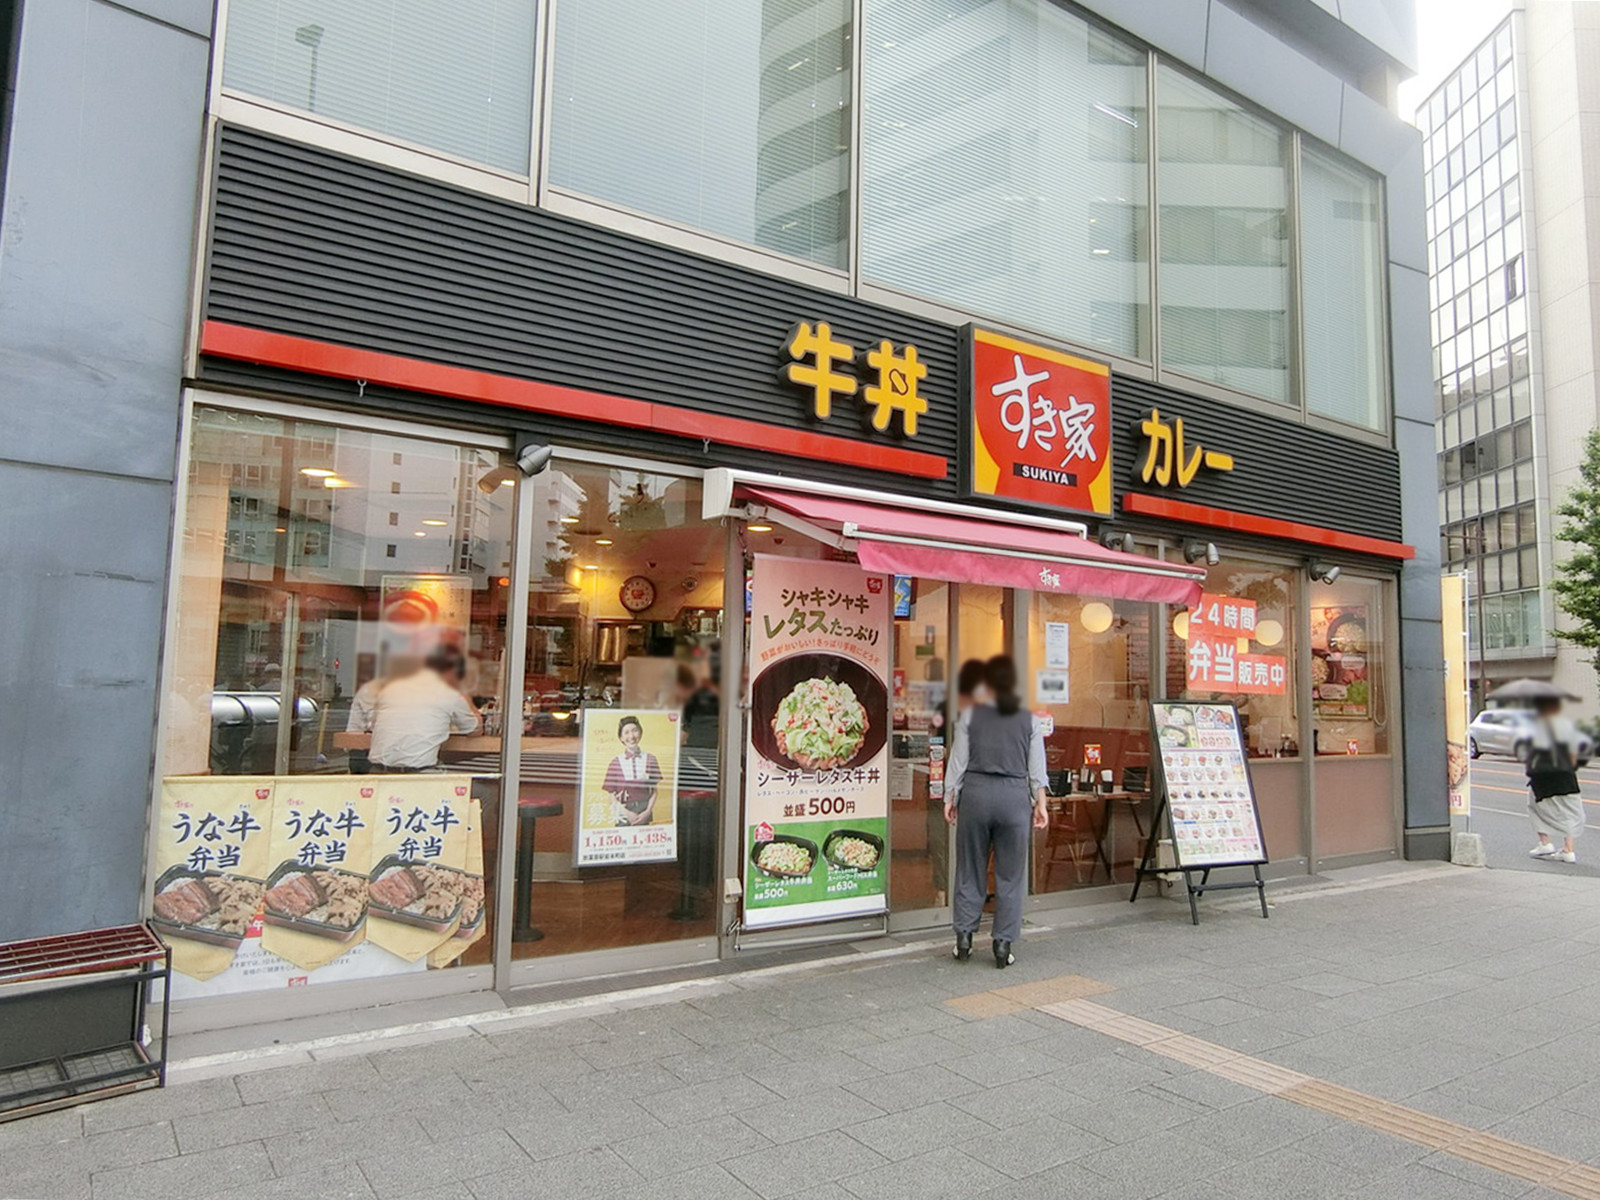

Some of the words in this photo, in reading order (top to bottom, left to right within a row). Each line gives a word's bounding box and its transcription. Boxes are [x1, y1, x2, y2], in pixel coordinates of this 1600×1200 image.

[787, 321, 929, 437] 牛丼
[991, 354, 1098, 468] すき家
[1141, 407, 1235, 488] カレー
[1021, 464, 1069, 486] SUKIYA
[781, 587, 870, 614] シャキシャキ
[763, 608, 879, 646] レタスたっぷり
[1189, 602, 1257, 631] 24時間
[757, 768, 881, 787] シーザーレタス牛丼
[172, 811, 262, 844] うな牛
[285, 808, 365, 839] うな牛
[386, 805, 460, 836] うな牛
[187, 844, 240, 871] 弁当
[298, 839, 346, 865] 弁当
[398, 836, 443, 860] 弁当
